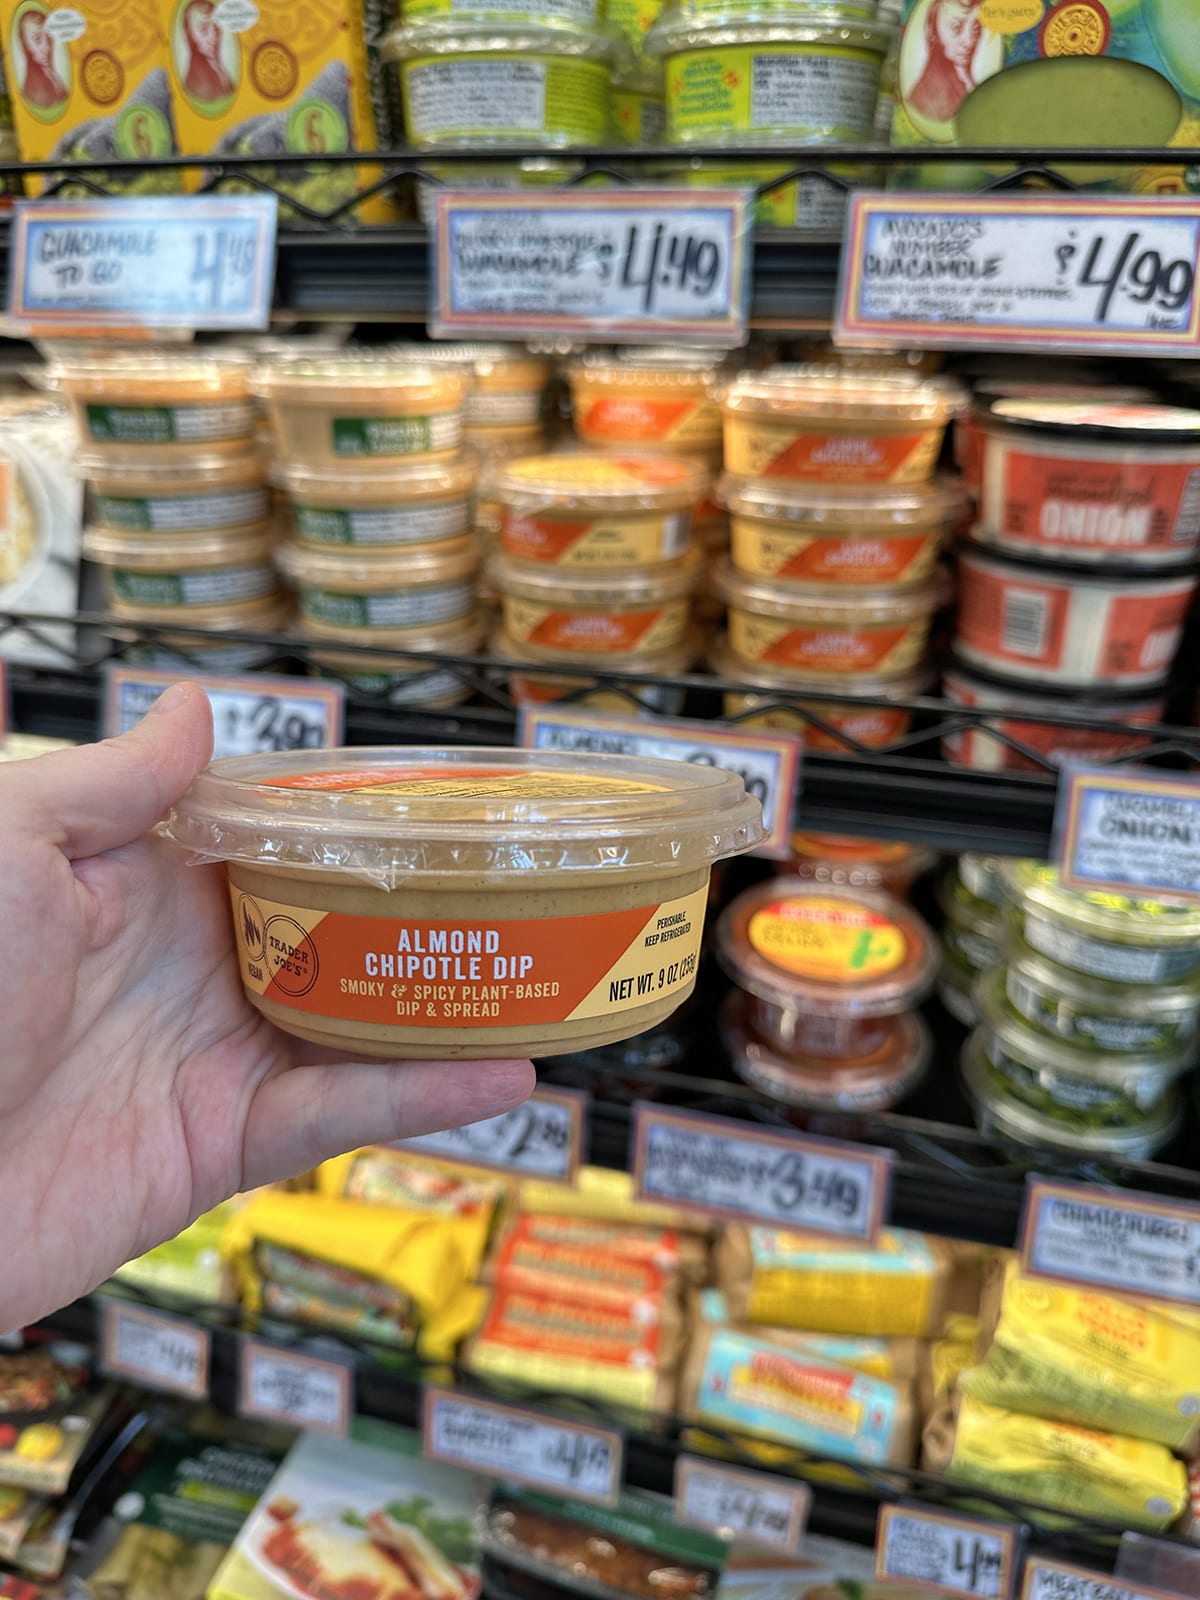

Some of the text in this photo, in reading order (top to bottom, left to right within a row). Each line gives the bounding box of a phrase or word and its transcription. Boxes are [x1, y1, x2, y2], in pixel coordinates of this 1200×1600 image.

[1039, 499, 1150, 545] ONION
[656, 911, 687, 930] PERISHABLE
[397, 928, 500, 954] ALMOND
[644, 922, 692, 948] KEEP REFRIGERATED
[269, 935, 309, 964] TRADER
[364, 952, 534, 980] CHIPOTLE DIP
[340, 978, 560, 1001] SMOKY & SPICY PLANT-BASED
[609, 978, 635, 1003] NET
[636, 972, 655, 996] WT.
[658, 968, 666, 989] 9
[667, 962, 679, 985] OZ
[396, 1000, 500, 1018] DIP & SPREAD
